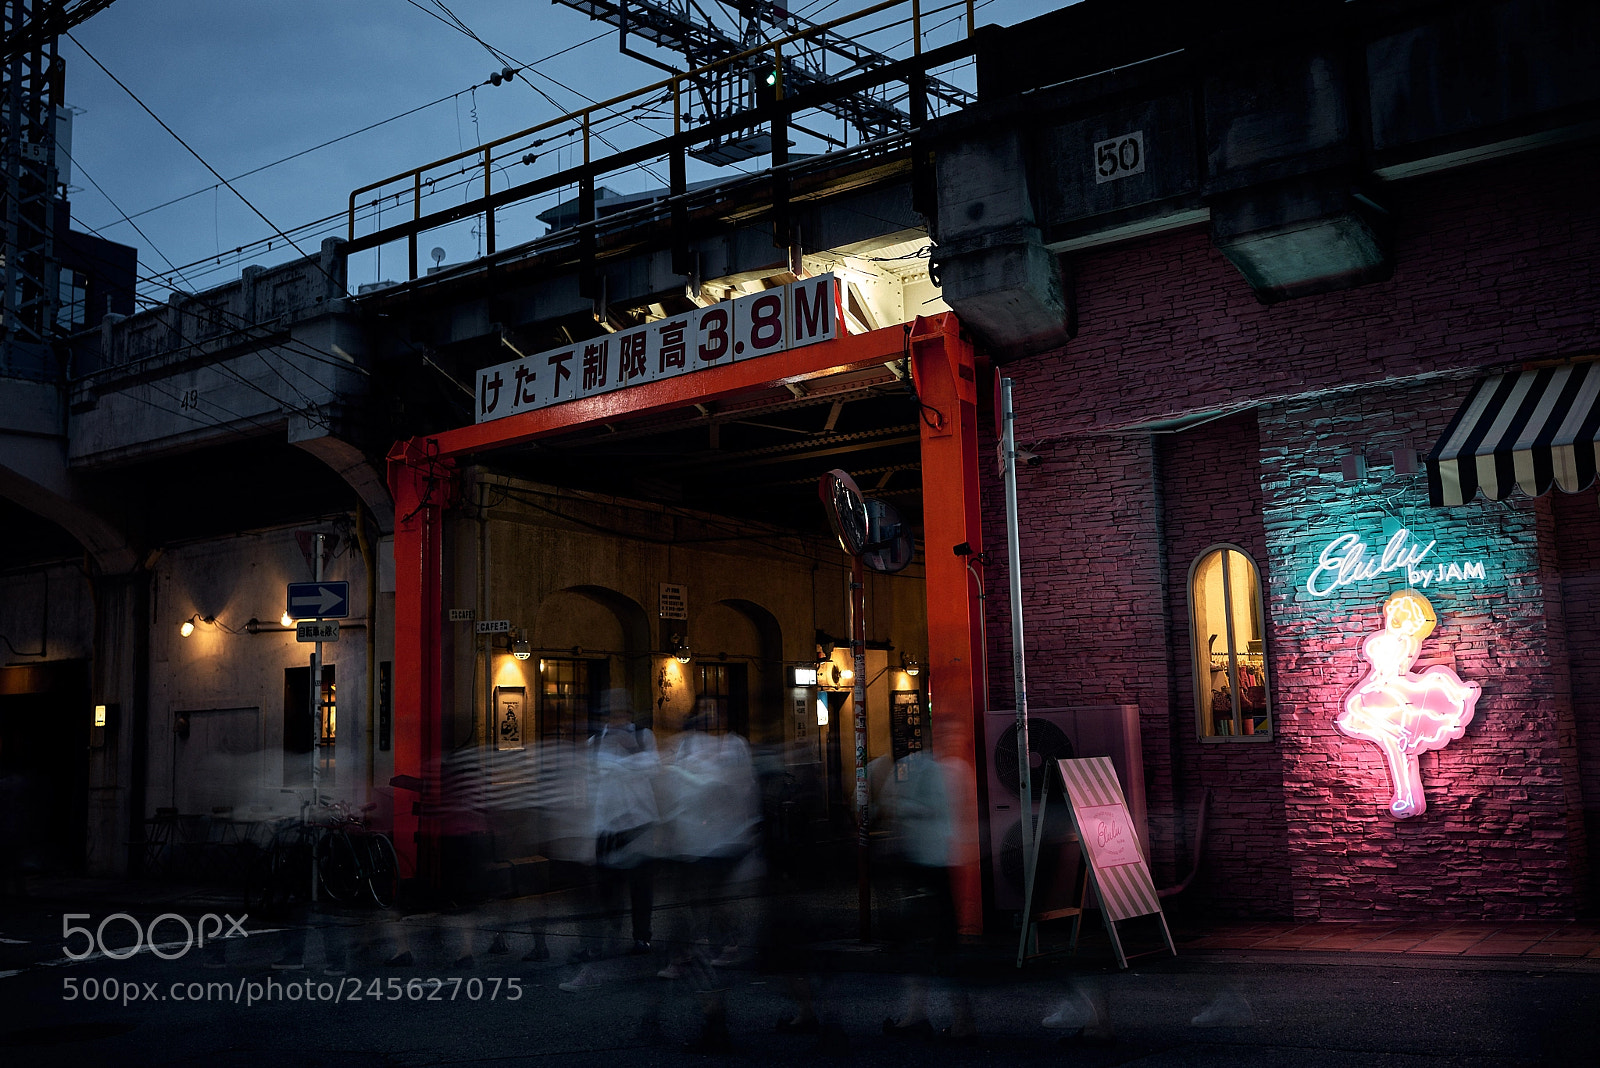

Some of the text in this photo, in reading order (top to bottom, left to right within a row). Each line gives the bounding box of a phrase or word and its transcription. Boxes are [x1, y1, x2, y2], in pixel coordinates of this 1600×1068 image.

[1097, 137, 1140, 177] 50
[1306, 528, 1437, 597] Elulu
[1407, 560, 1486, 588] by JAM
[298, 625, 337, 638] 自転車を除く
[480, 622, 499, 632] CAFE
[1097, 820, 1123, 848] Elulu
